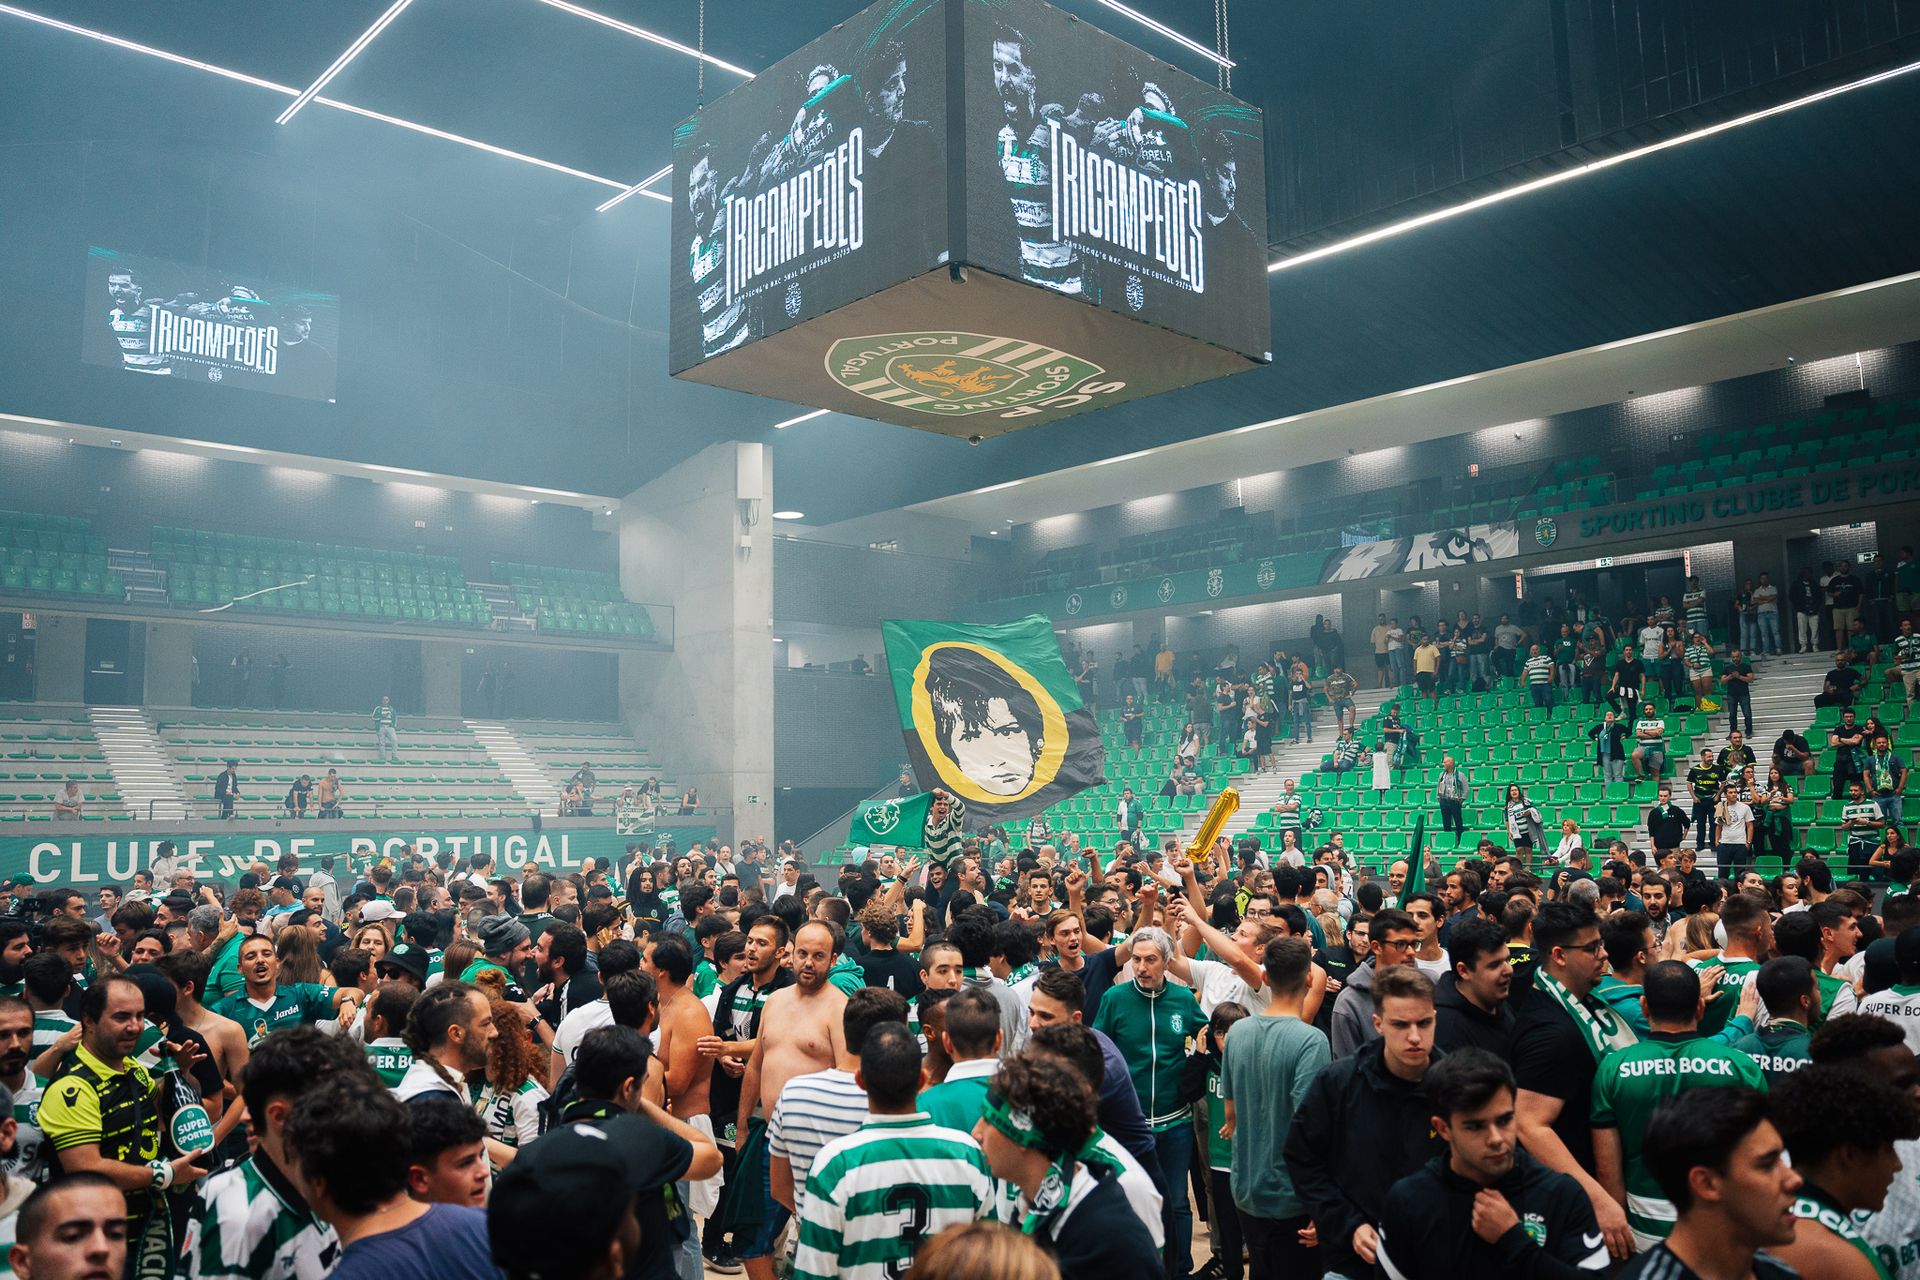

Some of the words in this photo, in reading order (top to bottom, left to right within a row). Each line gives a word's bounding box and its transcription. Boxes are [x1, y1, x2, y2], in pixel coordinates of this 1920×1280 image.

[724, 127, 863, 306] TRICAMPEÕES
[1047, 117, 1204, 294] TRICAMPEÕES
[149, 304, 279, 375] TRICAMPEÕES
[841, 336, 958, 379] PORTUGAL
[934, 366, 1070, 410] SPORTING
[1000, 381, 1127, 418] SCP
[1580, 500, 1705, 538] SPORTING
[1711, 481, 1804, 518] CLUBE
[1810, 476, 1850, 505] DE
[29, 840, 215, 883] CLUE
[273, 1004, 299, 1021] Jardel
[1865, 1003, 1901, 1016] SUPER
[1619, 1058, 1676, 1077] SUPER
[1679, 1056, 1734, 1076] BOCK
[177, 1118, 208, 1135] SUPER
[1789, 1199, 1859, 1239] OCK
[141, 1219, 167, 1280] NACI
